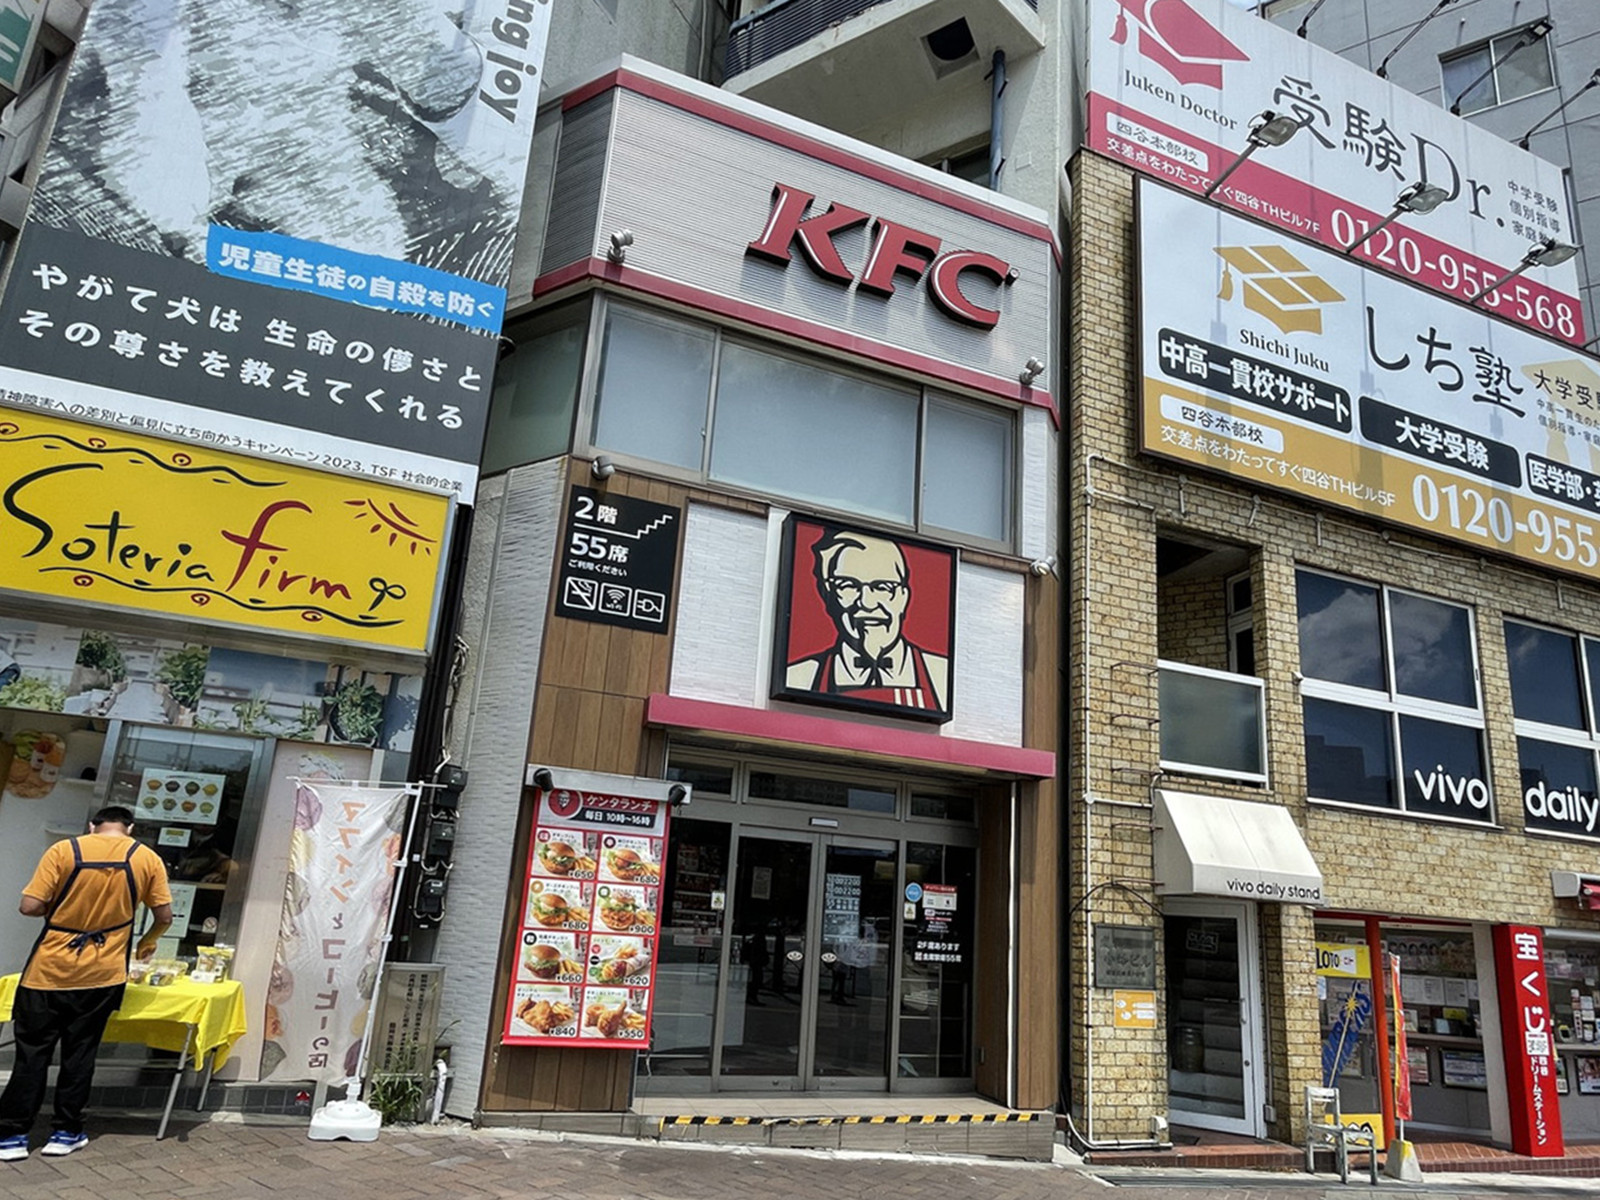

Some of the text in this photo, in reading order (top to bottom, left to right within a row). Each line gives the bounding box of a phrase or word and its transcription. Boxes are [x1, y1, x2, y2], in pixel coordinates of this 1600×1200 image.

[478, 50, 538, 124] joy
[1124, 69, 1238, 131] Juken Doctor
[1116, 121, 1199, 166] 四谷本部校
[1273, 75, 1505, 228] 受験Dr.
[1509, 199, 1560, 233] 個別指導
[218, 242, 496, 318] 児童生徒の自殺を防ぐ
[745, 182, 1011, 331] KFC
[1331, 208, 1576, 338] 0120-955-568
[32, 263, 242, 333] やがて犬は
[264, 318, 482, 392] 生命の儚さと
[1240, 329, 1330, 373] Shichi Juku
[19, 309, 464, 429] その尊さを教えてくれる
[1161, 336, 1350, 423] 中高一貫校サポート
[1366, 305, 1526, 418] しち塾
[1533, 369, 1600, 411] 大学受
[1181, 405, 1264, 444] 四谷本部校
[1395, 416, 1490, 471] 大学受験
[371, 464, 398, 479] TSF
[401, 470, 463, 492] 社会的企業
[1161, 425, 1396, 507] 交差点をわたってすぐ四谷THビル5F
[3, 462, 353, 600] Soteria firm
[574, 496, 618, 525] 2階
[570, 532, 629, 563] 55席
[585, 810, 603, 821] 毎日
[586, 794, 652, 811] ケンタランチ
[1414, 764, 1600, 832] vivo daily
[1227, 879, 1320, 900] vivo daily stand
[1514, 933, 1546, 1033] 宝くじ
